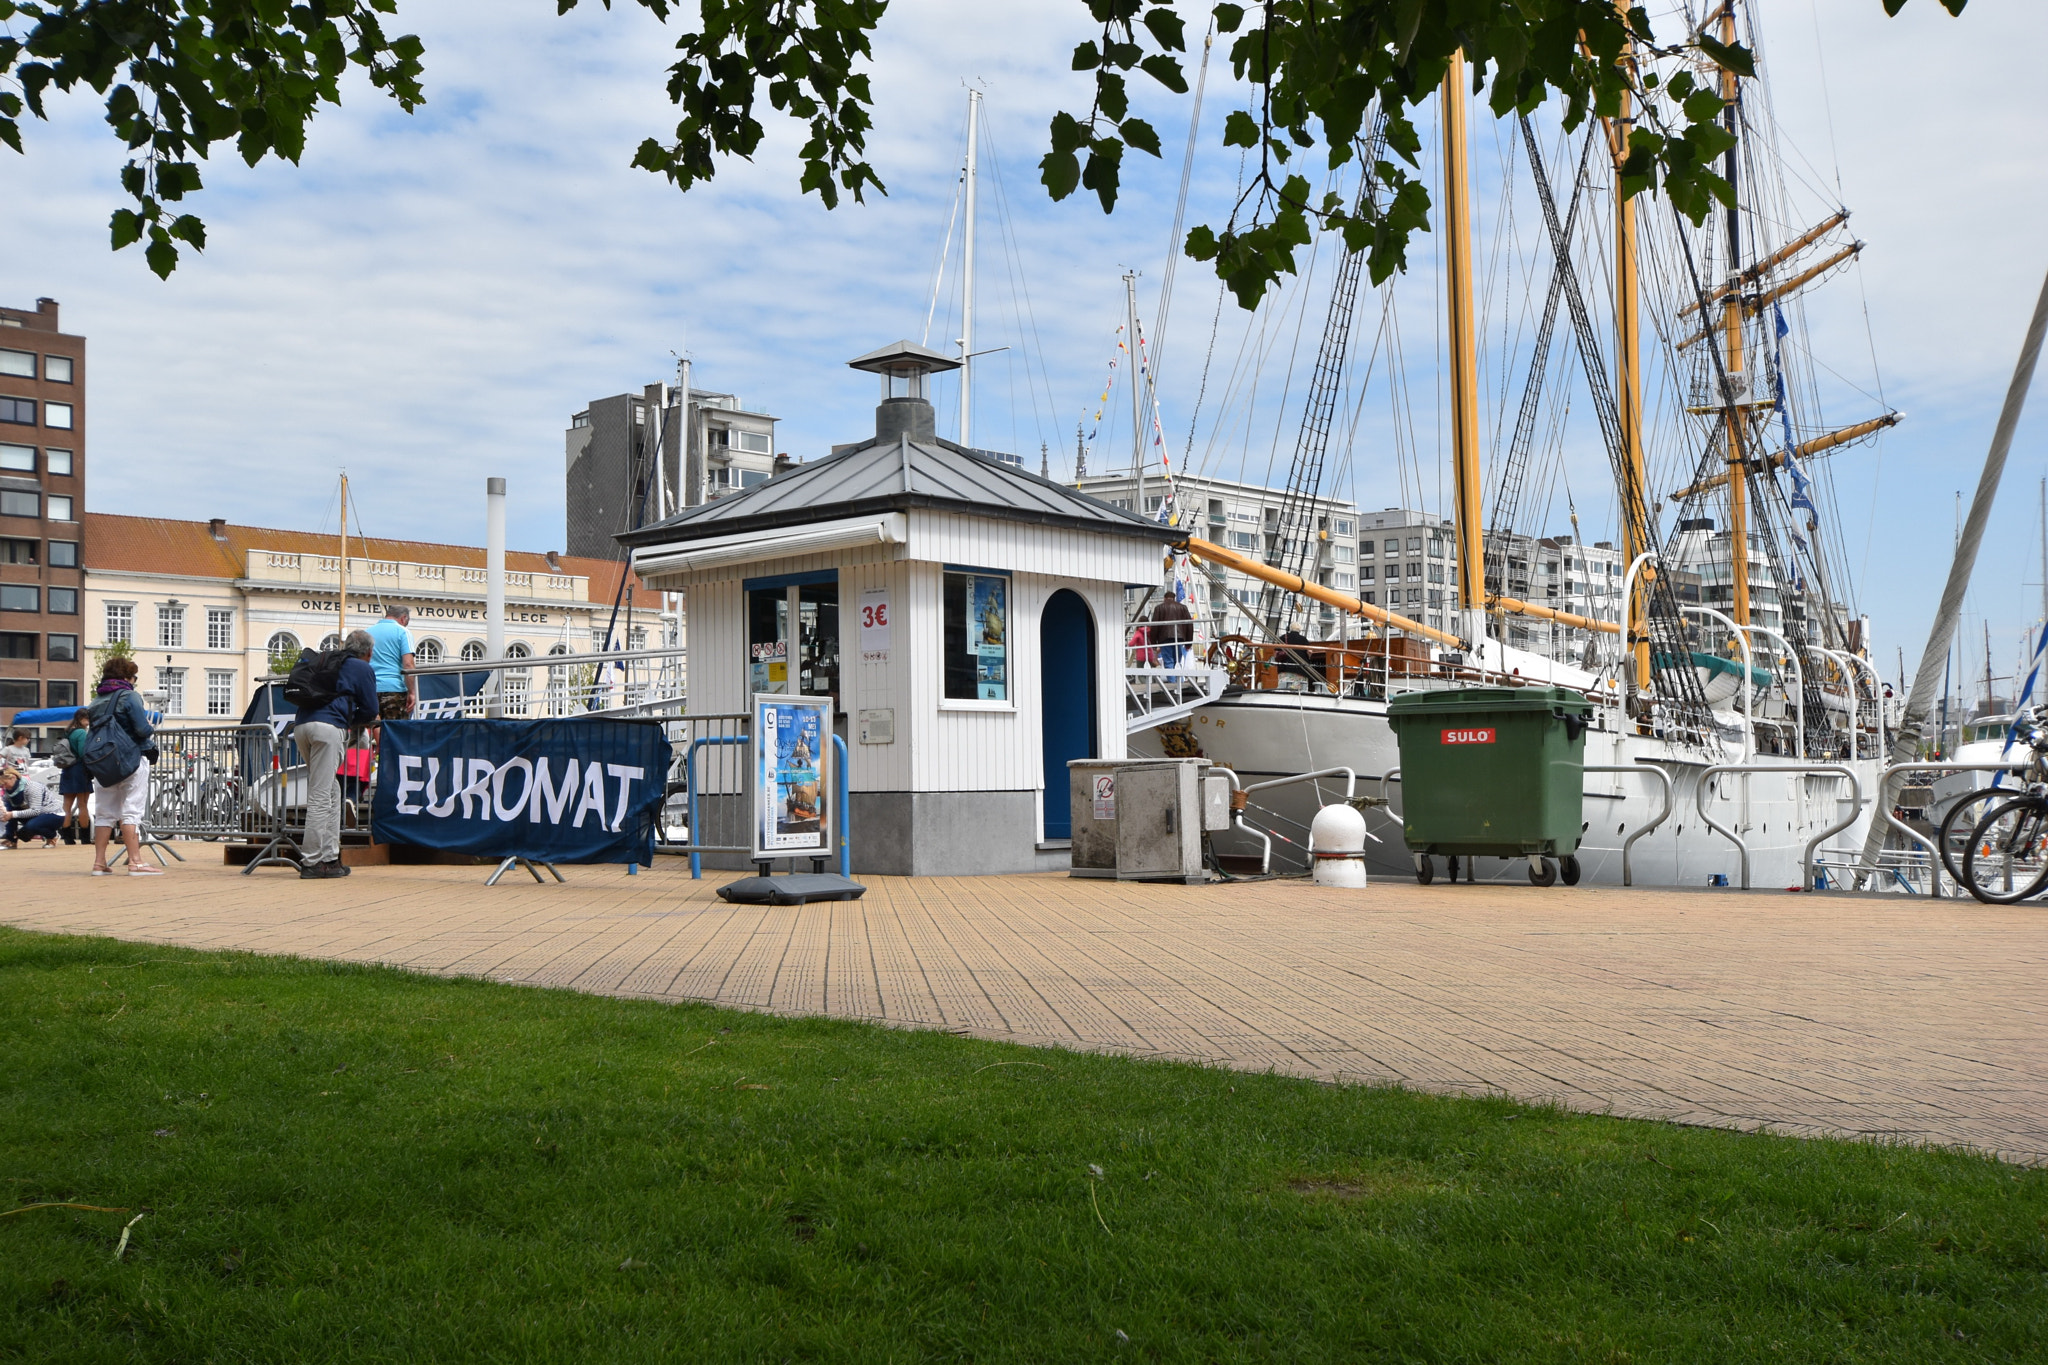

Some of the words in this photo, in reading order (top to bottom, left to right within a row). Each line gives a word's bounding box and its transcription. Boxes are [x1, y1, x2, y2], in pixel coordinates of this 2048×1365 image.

[357, 603, 392, 614] LIEV
[416, 607, 479, 619] VROUWE
[862, 604, 888, 628] 3€
[1448, 731, 1488, 742] SULO
[396, 755, 645, 832] EUROMAT
